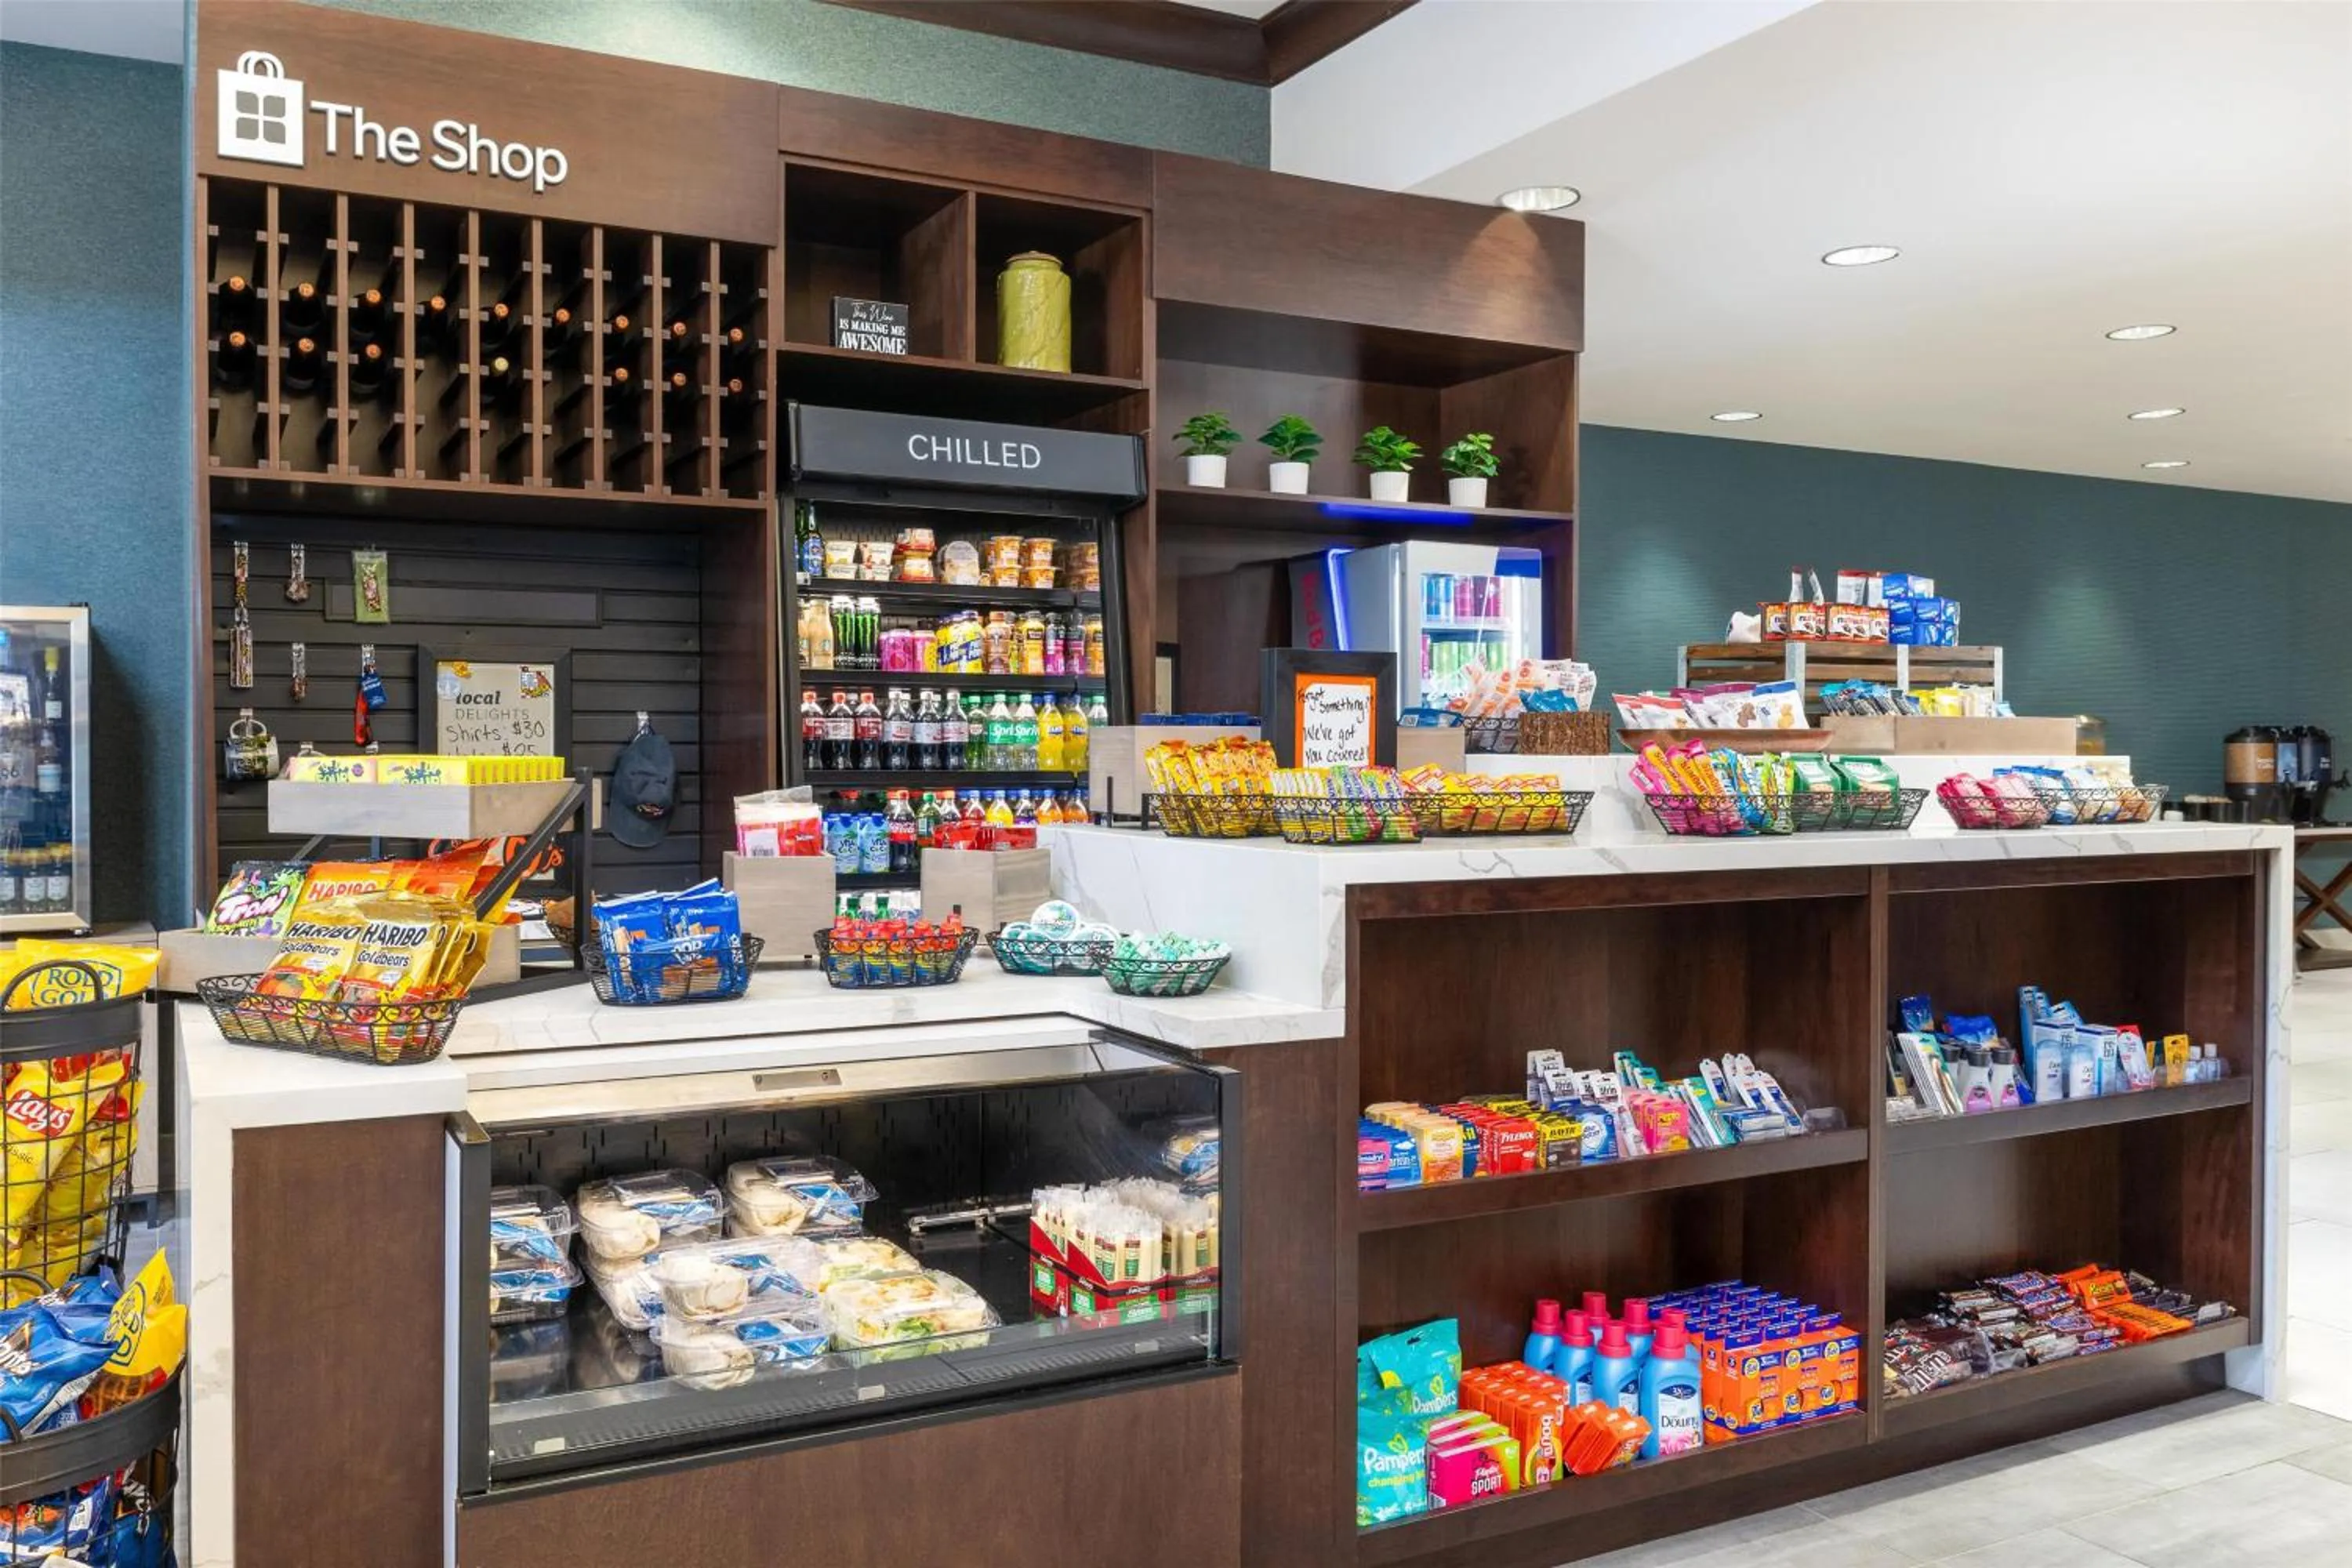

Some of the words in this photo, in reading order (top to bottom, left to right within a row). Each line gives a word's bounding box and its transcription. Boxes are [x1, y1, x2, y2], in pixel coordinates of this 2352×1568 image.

[310, 100, 420, 165] The
[430, 120, 568, 193] Shop
[839, 318, 849, 329] IS
[851, 320, 888, 335] MAKING
[891, 325, 906, 336] ME
[839, 330, 906, 355] AWESOME
[908, 434, 1041, 468] CHILLED
[455, 708, 530, 721] DELIGHTS
[512, 720, 546, 739] $30
[288, 923, 361, 941] HARIBO
[361, 924, 428, 947] HARIBO
[40, 989, 109, 1006] GOL
[8, 1090, 71, 1131] Lay's
[1661, 1415, 1699, 1429] Downy
[1363, 1446, 1425, 1475] Pamper
[1471, 1474, 1503, 1496] SPORT
